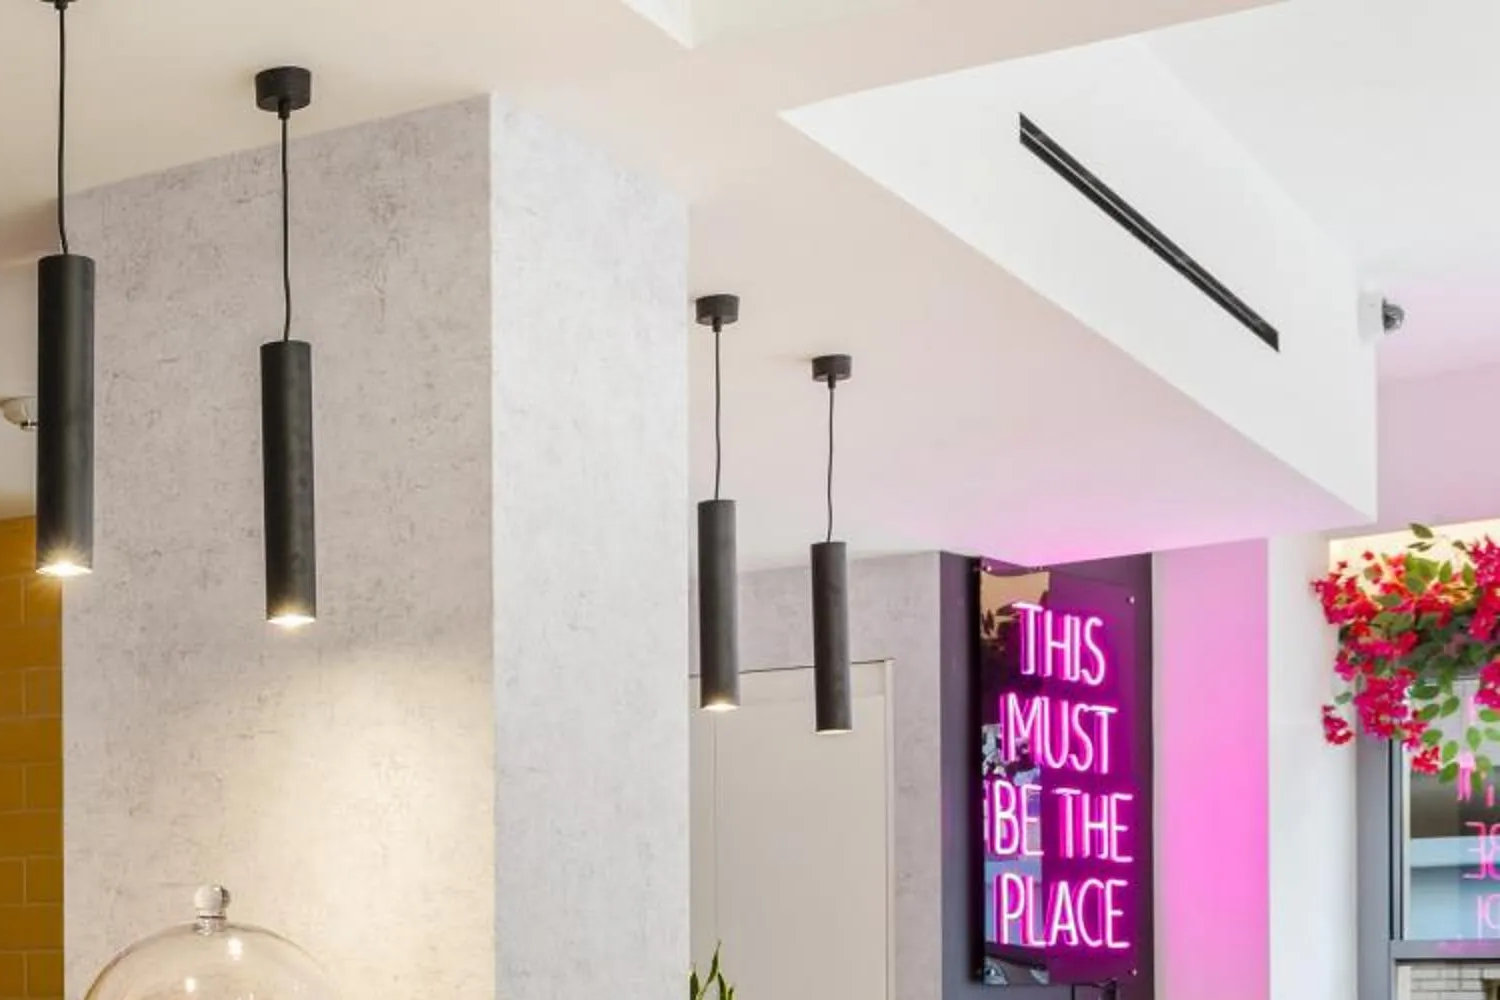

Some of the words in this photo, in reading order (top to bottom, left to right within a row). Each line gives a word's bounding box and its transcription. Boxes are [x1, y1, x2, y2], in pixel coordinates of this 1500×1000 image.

[1011, 602, 1105, 686] THIS
[1004, 692, 1118, 775] MUST
[993, 780, 1044, 855] BE
[1053, 787, 1134, 863] THE
[1001, 872, 1130, 949] PLACE
